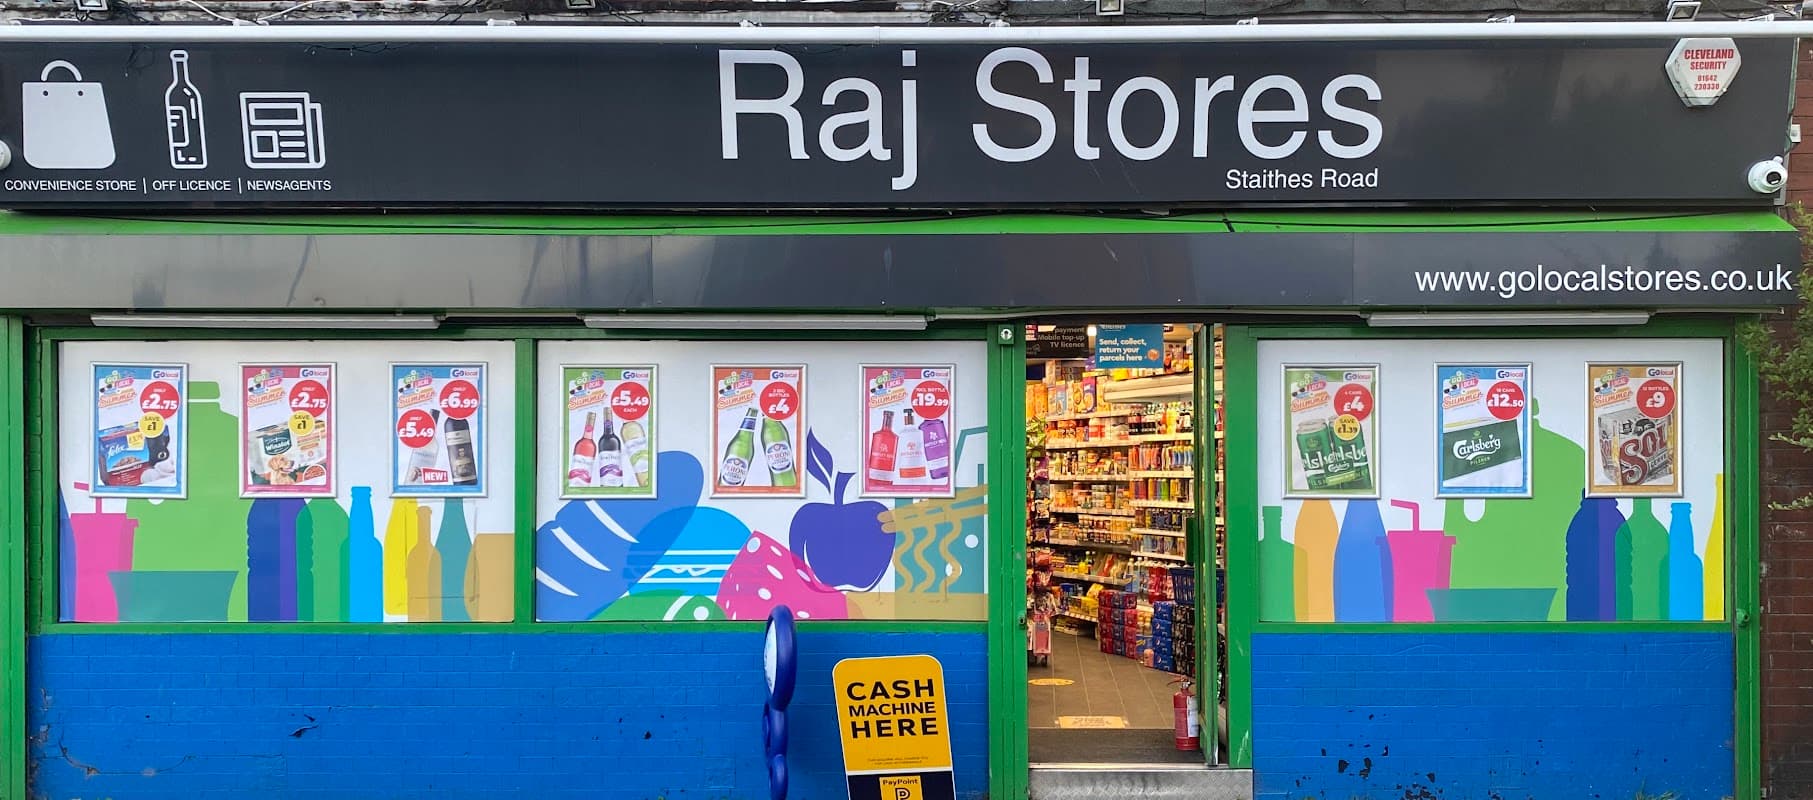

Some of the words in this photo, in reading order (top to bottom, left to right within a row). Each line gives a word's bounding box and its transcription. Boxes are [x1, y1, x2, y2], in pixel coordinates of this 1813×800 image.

[1684, 48, 1735, 60] CLEVELAND
[1690, 61, 1727, 71] SECURITY
[719, 49, 917, 190] Raj
[972, 47, 1382, 162] Stores
[5, 179, 93, 191] CONVENIENCE
[96, 179, 137, 191] STORE
[152, 179, 177, 191] OFF
[180, 179, 232, 191] LICENCE
[247, 179, 332, 191] NEWSAGENTS
[1226, 169, 1313, 189] Staithes
[1321, 168, 1378, 188] Road
[1415, 263, 1793, 299] www.golocalstores.co.uk
[142, 393, 178, 410] £2.75
[291, 391, 327, 409] £2.75
[440, 392, 478, 409] £6.99
[612, 390, 649, 406] £5.49
[768, 398, 790, 414] £4
[912, 393, 949, 407] £19.99
[1343, 396, 1365, 412] £4
[1487, 393, 1523, 407] £12.50
[1645, 391, 1666, 408] £9
[147, 421, 157, 431] £1
[398, 421, 434, 438] £5.49
[1453, 437, 1501, 460] Carlsberg
[424, 471, 448, 481] NEW!
[846, 678, 935, 701] CASH
[848, 701, 937, 717] MACHINE
[850, 717, 939, 739] HERE
[882, 778, 918, 787] PayPoint
